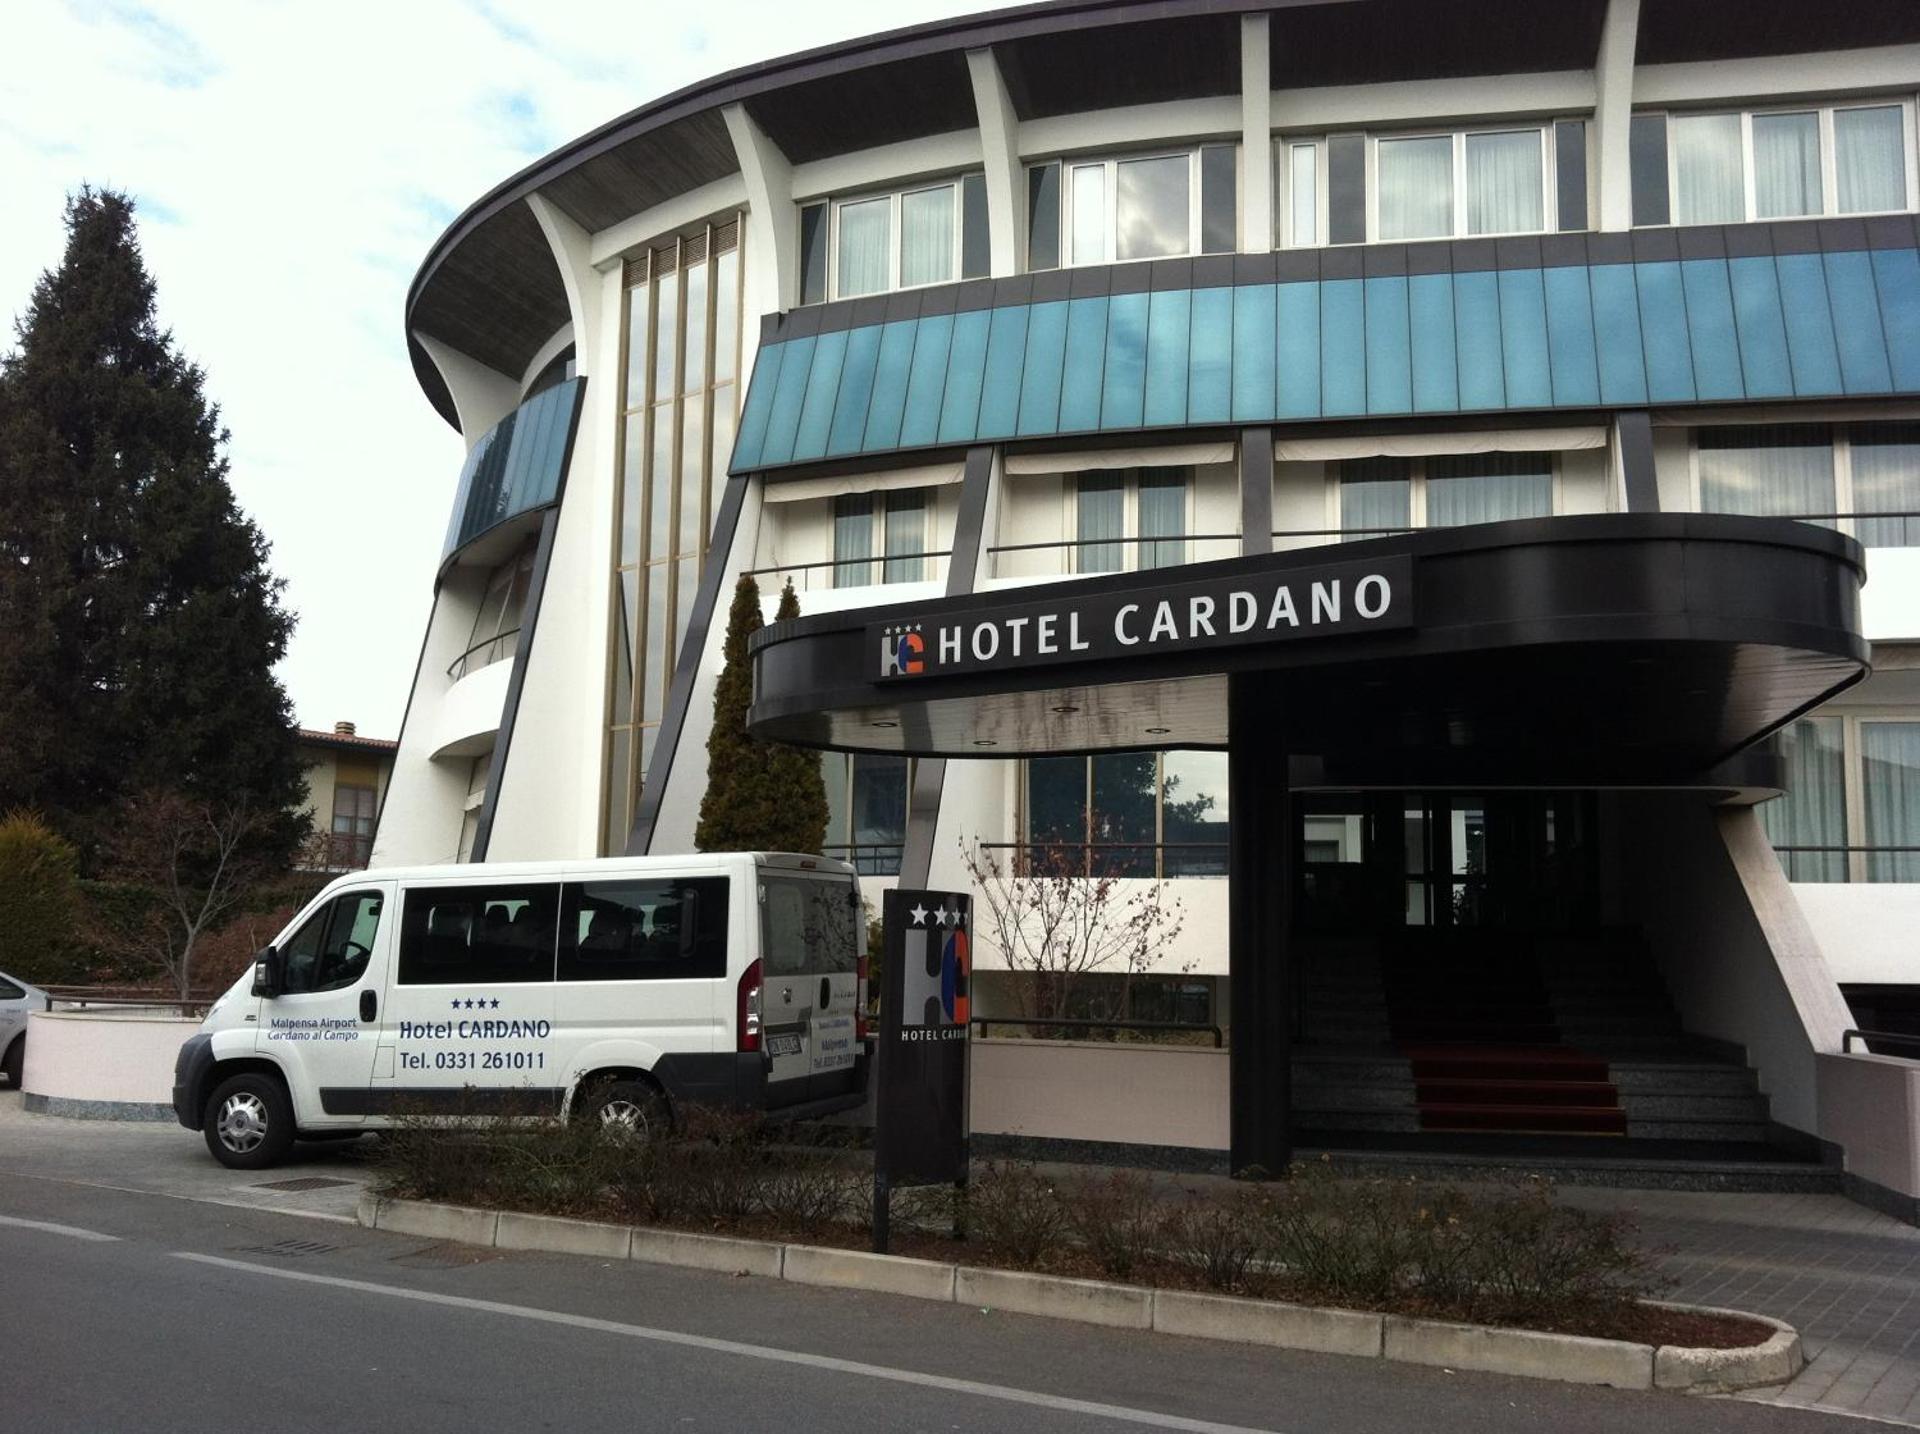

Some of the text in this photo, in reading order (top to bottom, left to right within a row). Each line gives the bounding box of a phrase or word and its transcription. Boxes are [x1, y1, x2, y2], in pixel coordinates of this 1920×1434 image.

[938, 573, 1392, 665] HOTEL CARDANO
[270, 1018, 357, 1030] Malpensa Airport
[400, 1019, 551, 1039] Hotel CARDANO
[268, 1029, 359, 1042] Cardano al Campo
[901, 1030, 938, 1041] HOTEL
[400, 1052, 545, 1069] Tel. 0331 261011
